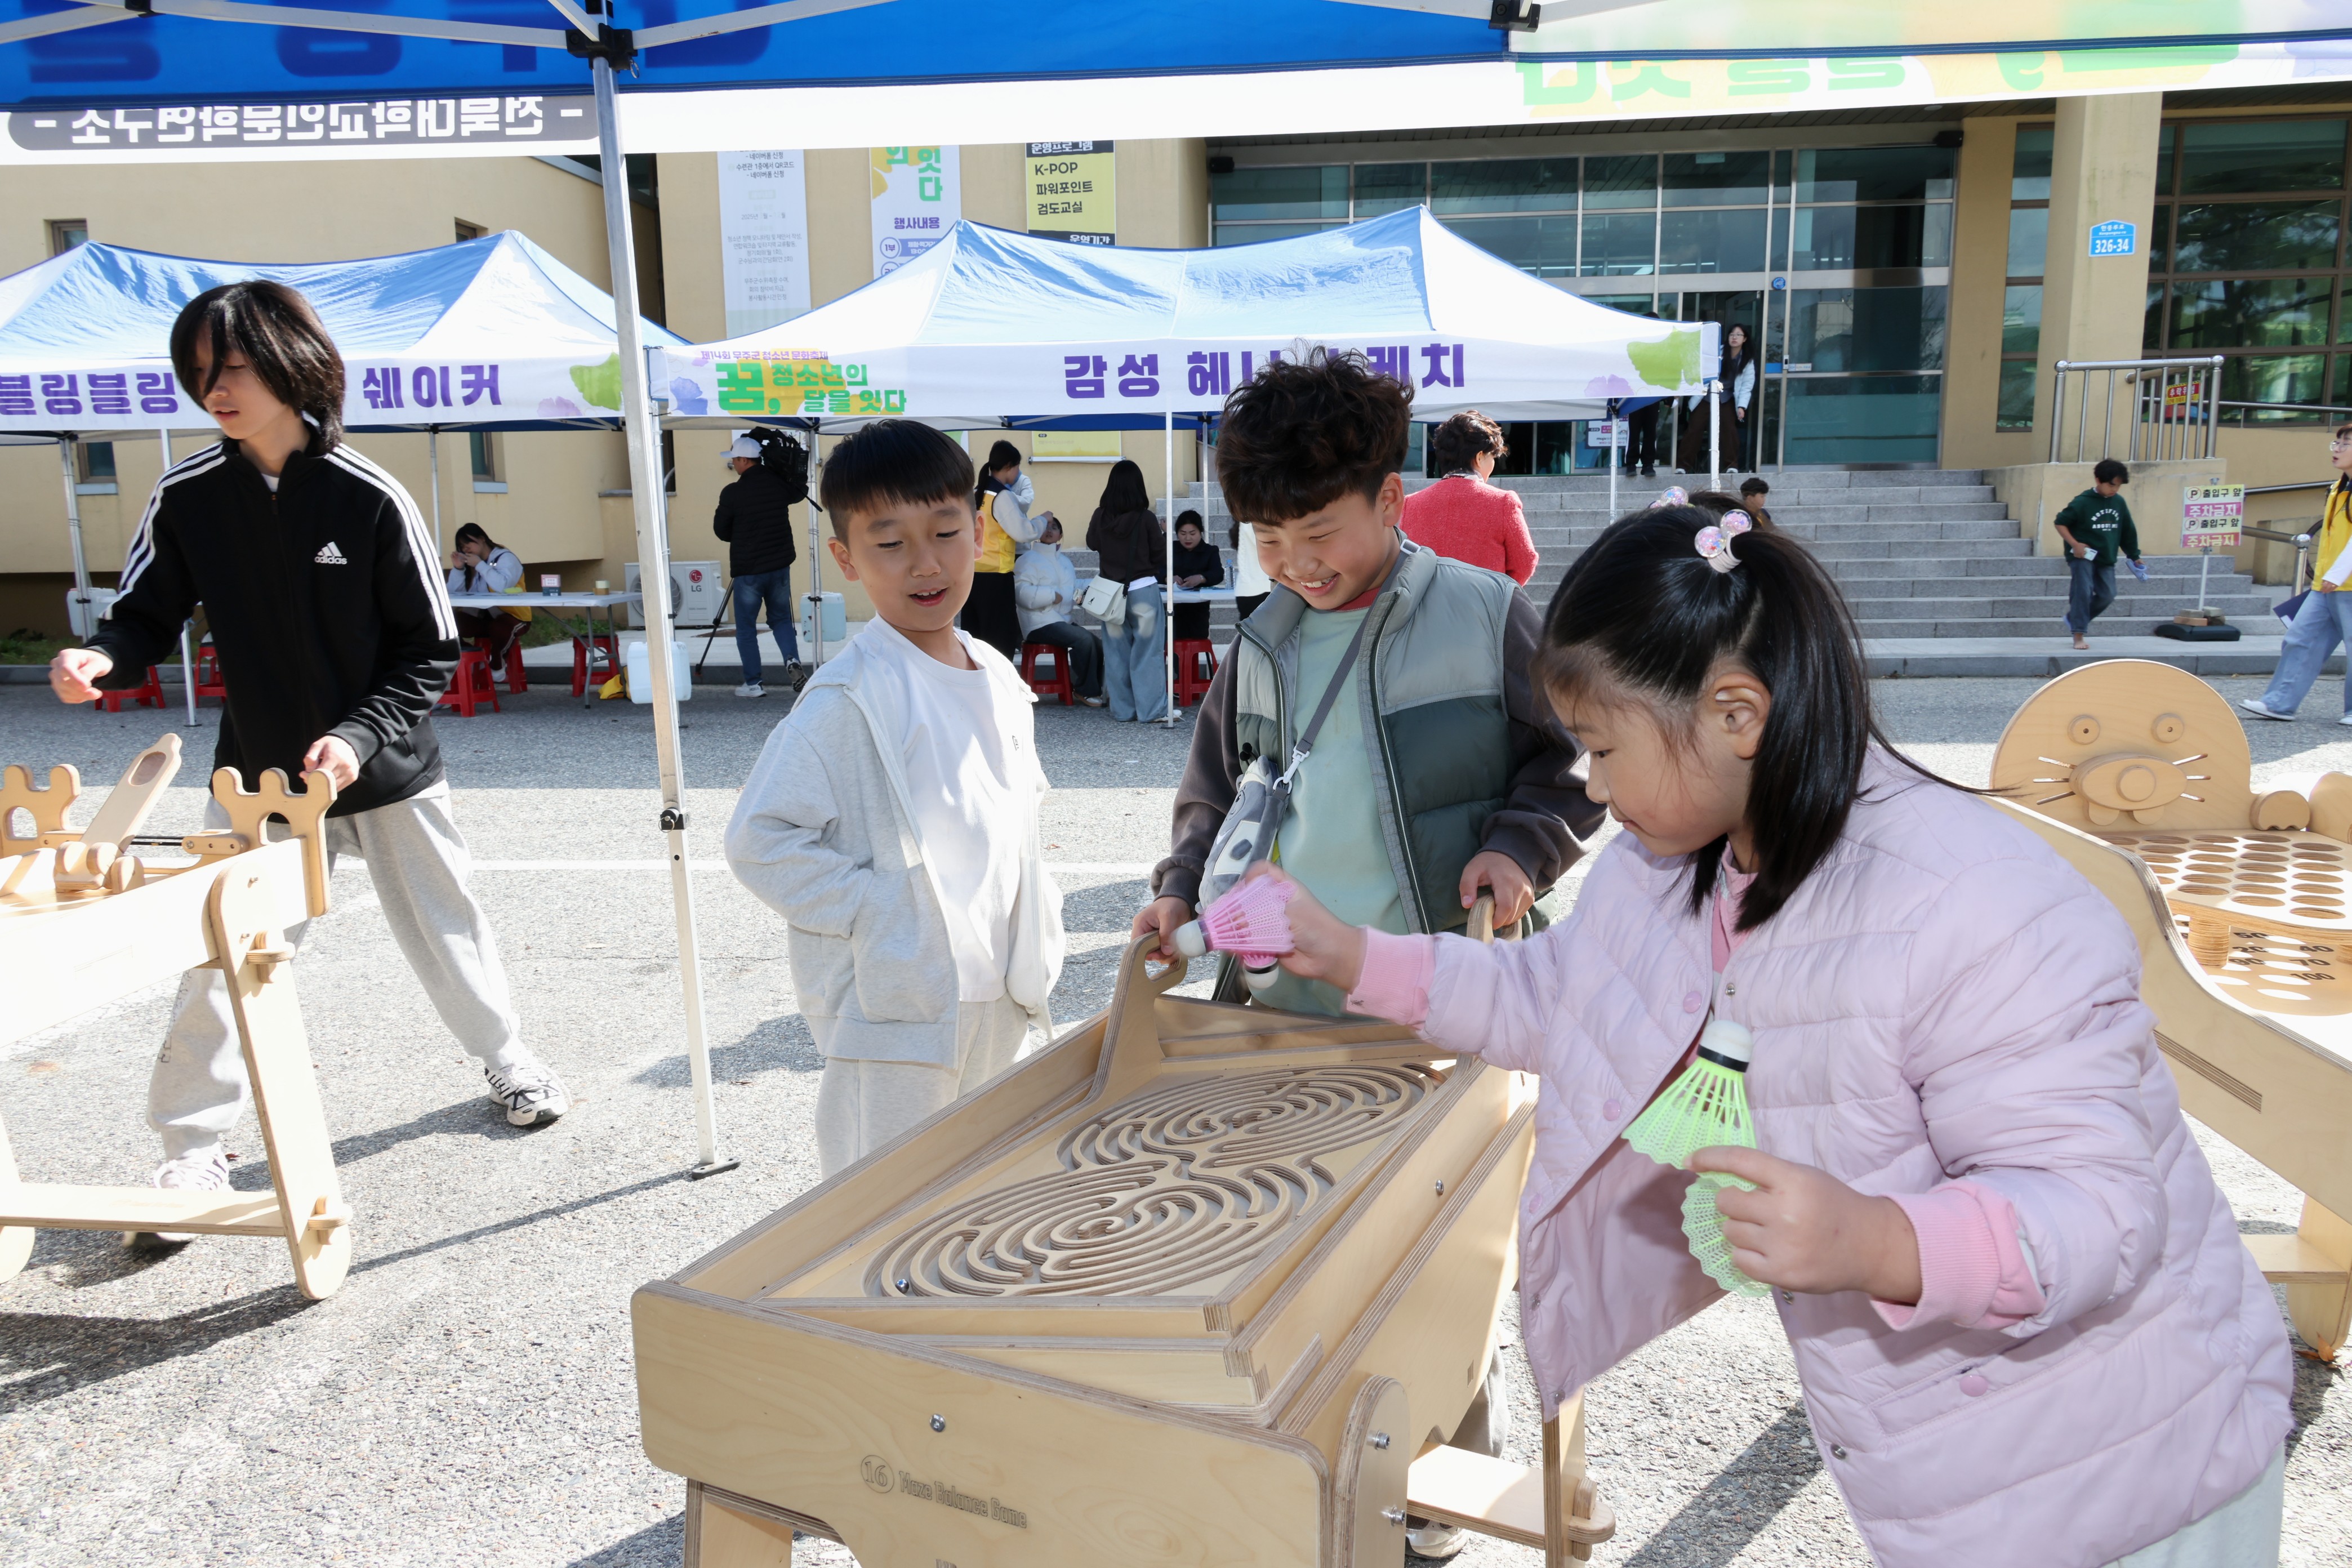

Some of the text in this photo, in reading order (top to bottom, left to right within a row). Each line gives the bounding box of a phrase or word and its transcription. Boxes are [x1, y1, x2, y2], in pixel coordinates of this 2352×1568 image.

[1035, 162, 1078, 176] K-POP
[1036, 181, 1093, 195] 파워포인트
[1037, 201, 1083, 215] 검도교실
[894, 217, 940, 230] 행사내용
[2095, 238, 2129, 253] 326-34
[700, 351, 730, 360] 제14회
[762, 351, 789, 360] 청소년
[772, 364, 868, 386] 청소년의
[1064, 354, 1159, 399] 감성
[0, 364, 502, 416] 블링블링 쉐이커
[804, 389, 907, 413] 달을 잇다
[2203, 488, 2229, 498] 출입구
[2233, 488, 2242, 497] 앞
[2189, 504, 2237, 518] 주차금지
[2200, 519, 2227, 528] 출입구
[2231, 518, 2239, 527] 앞
[2187, 534, 2235, 547] 주차금지
[314, 555, 348, 565] adidas
[2290, 972, 2336, 981] 100
[864, 1460, 1027, 1529] 16 Maze Balance Game
